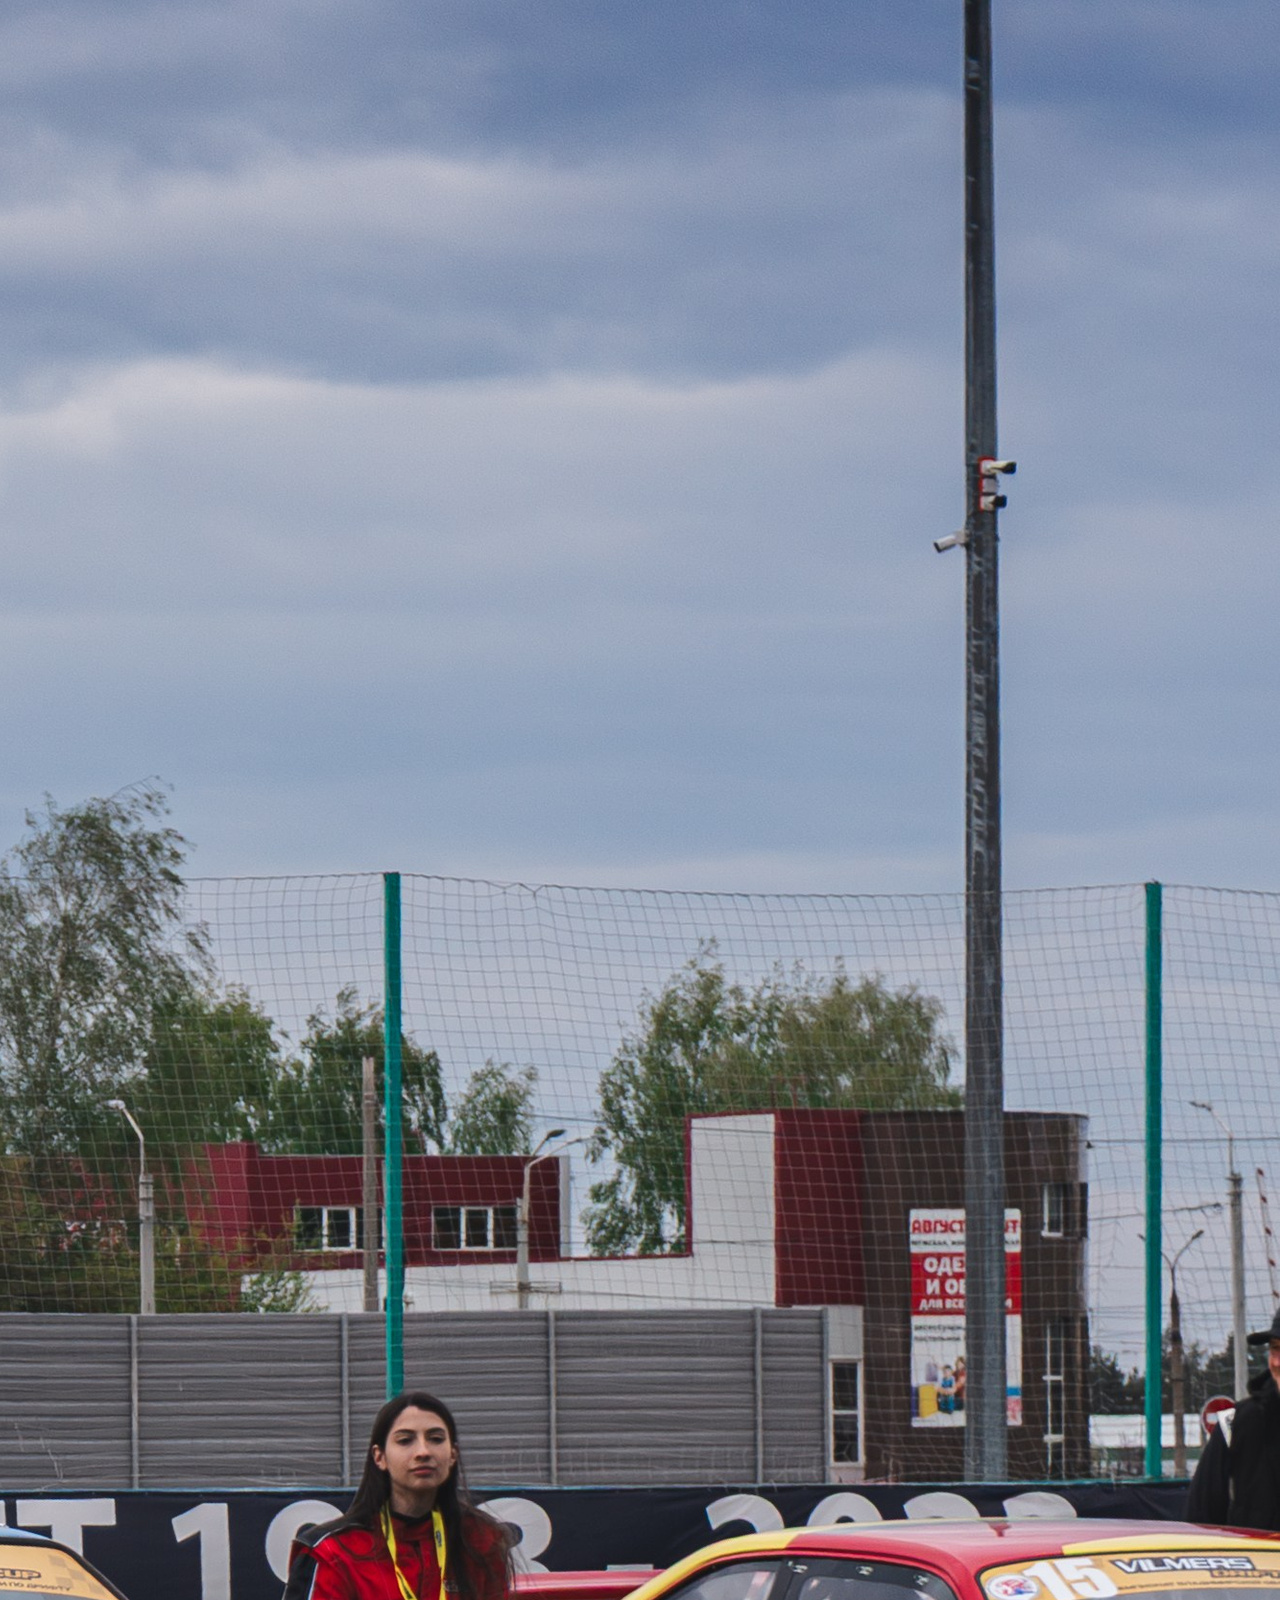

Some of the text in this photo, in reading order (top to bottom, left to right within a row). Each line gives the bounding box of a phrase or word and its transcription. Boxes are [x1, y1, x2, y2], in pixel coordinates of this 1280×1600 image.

[924, 1256, 966, 1276] ОДЕ
[926, 1279, 940, 1295] И
[945, 1298, 966, 1309] ВСЕ
[1115, 1556, 1252, 1573] VILMERS
